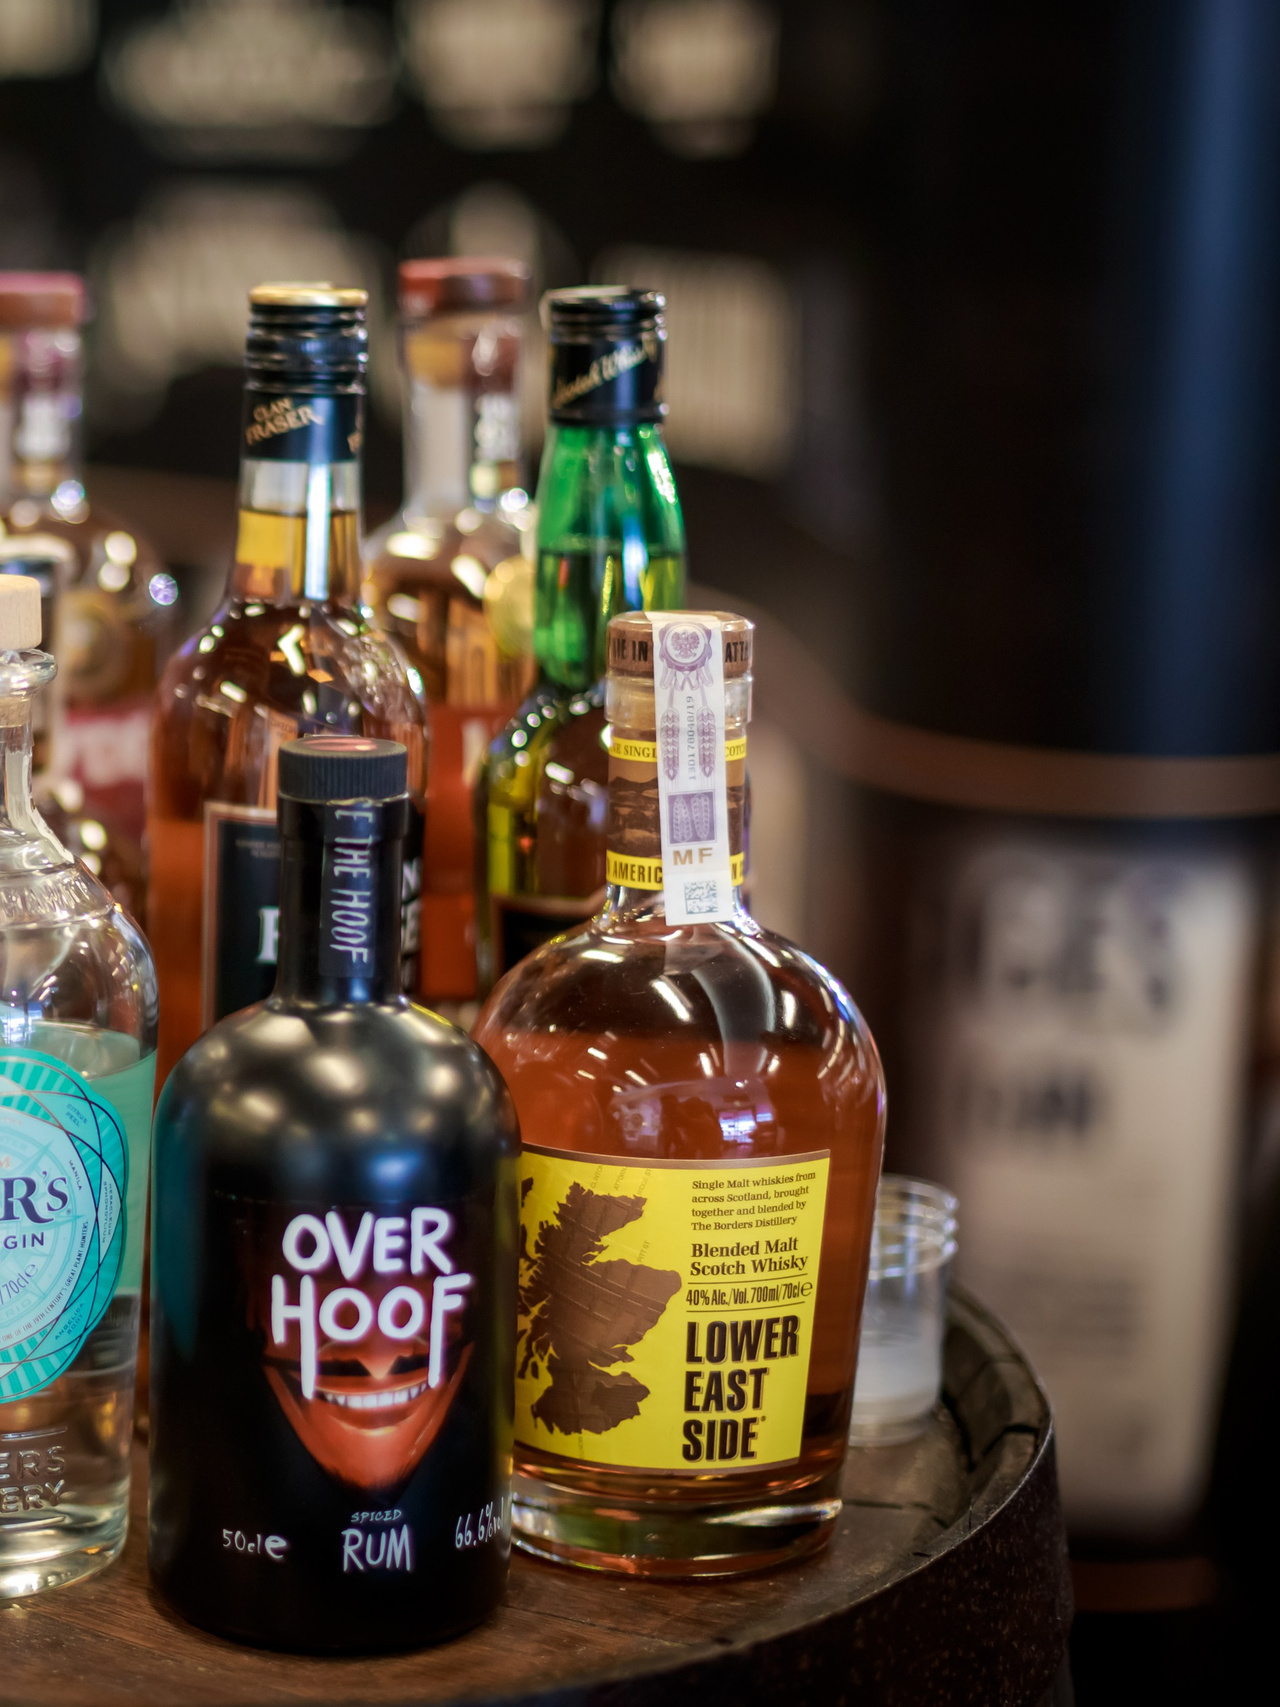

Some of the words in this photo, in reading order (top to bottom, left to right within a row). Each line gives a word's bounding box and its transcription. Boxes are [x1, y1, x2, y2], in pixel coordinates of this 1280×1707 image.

[245, 406, 325, 446] FRASER
[334, 835, 373, 878] THE
[330, 888, 371, 964] HOOF
[692, 1180, 725, 1191] Single
[727, 1178, 750, 1189] Malt
[752, 1176, 794, 1188] whiskies
[795, 1172, 816, 1182] from
[692, 1195, 725, 1203] across
[726, 1192, 771, 1204] Scotland,
[774, 1186, 810, 1199] brought
[691, 1208, 734, 1219] together
[736, 1206, 755, 1216] and
[757, 1201, 794, 1214] blended
[796, 1199, 807, 1210] by
[691, 1222, 712, 1231] The
[713, 1220, 753, 1231] Borders
[755, 1215, 798, 1228] Distillery
[3, 1231, 45, 1250] GIN
[65, 1268, 77, 1288] GREAT
[74, 1249, 84, 1268] PLANT
[80, 1221, 89, 1249] HUNTERS
[282, 1207, 452, 1281] OVER
[691, 1240, 759, 1258] Blended
[764, 1237, 798, 1255] Malt
[690, 1260, 746, 1276] Scotch
[751, 1255, 809, 1275] Whisky
[686, 1289, 710, 1306] 40%
[271, 1273, 473, 1400] HOOF
[685, 1315, 801, 1365] LOWER
[683, 1367, 769, 1414] EAST
[682, 1418, 759, 1463] SIDE
[350, 1508, 403, 1524] SPICED
[341, 1524, 413, 1573] RUM
